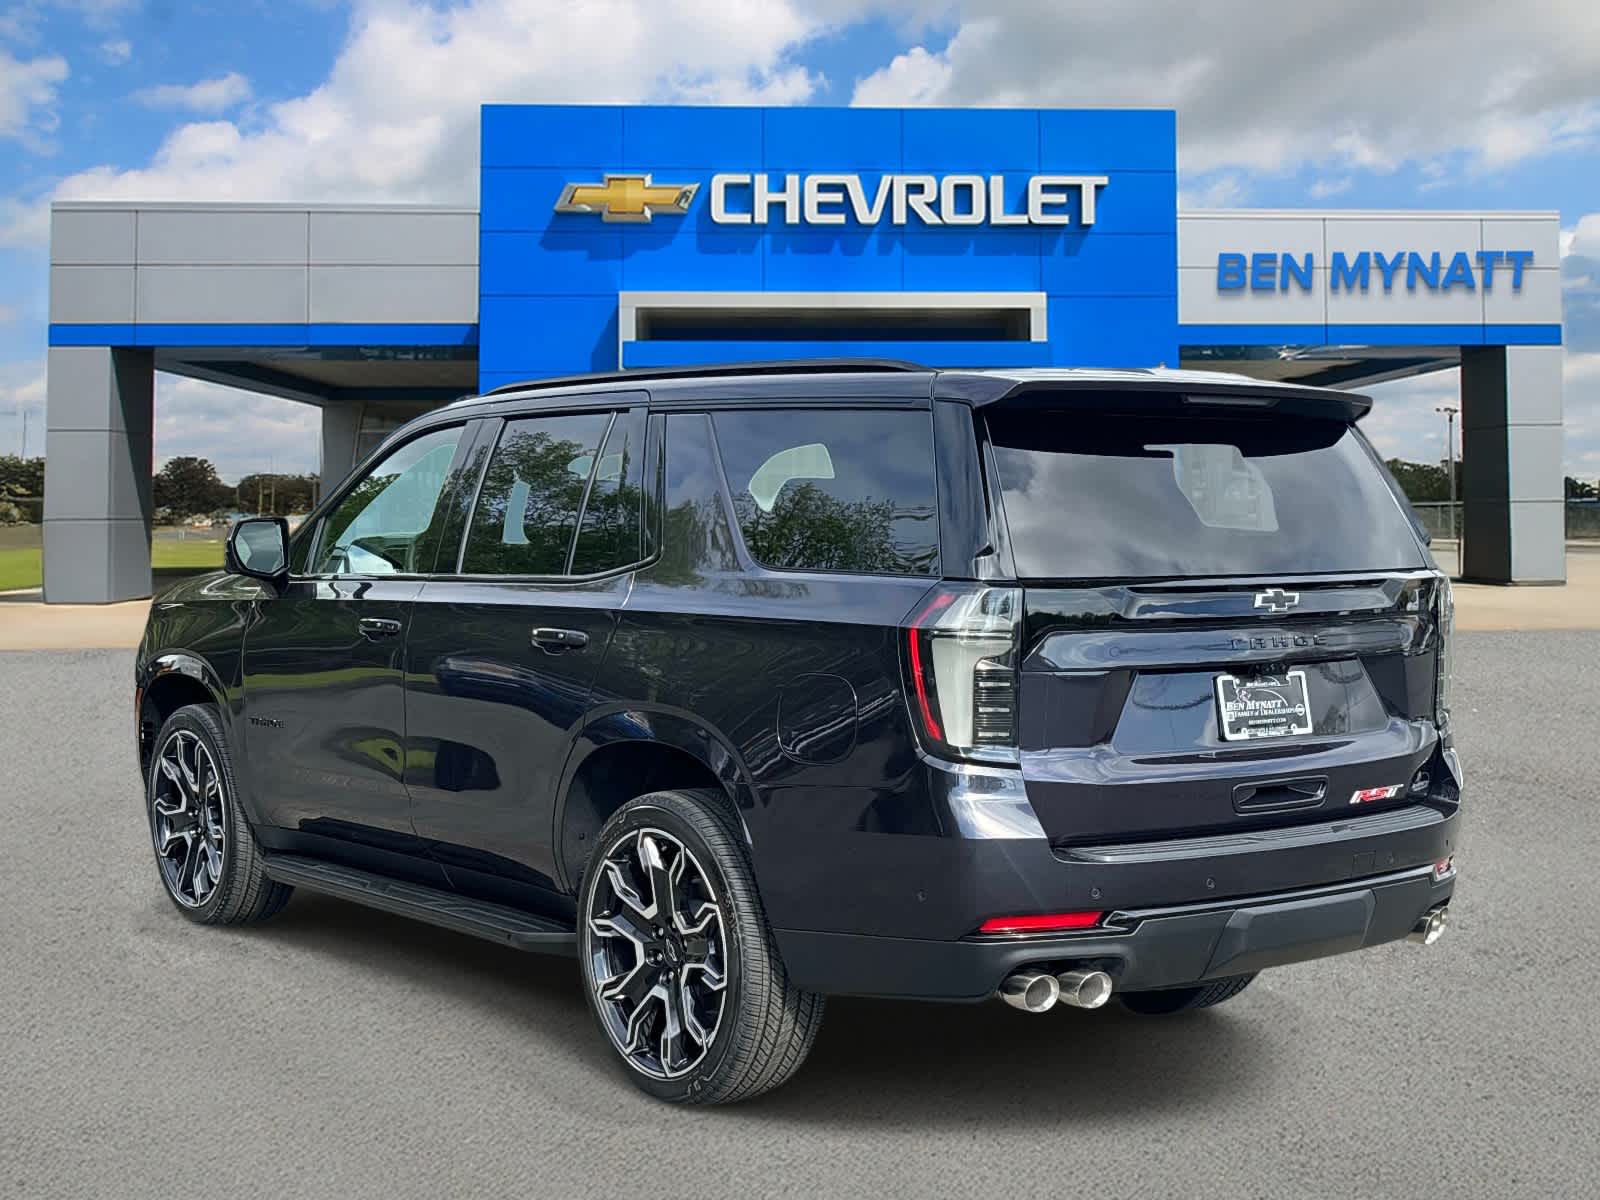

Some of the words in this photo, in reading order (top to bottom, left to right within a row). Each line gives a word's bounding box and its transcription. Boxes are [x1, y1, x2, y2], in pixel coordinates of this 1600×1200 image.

[710, 173, 1109, 226] CHEVROLET
[1217, 252, 1313, 290] BEN
[1330, 250, 1534, 290] MYNATT
[1226, 701, 1245, 711] BEN
[1350, 783, 1404, 804] RST
